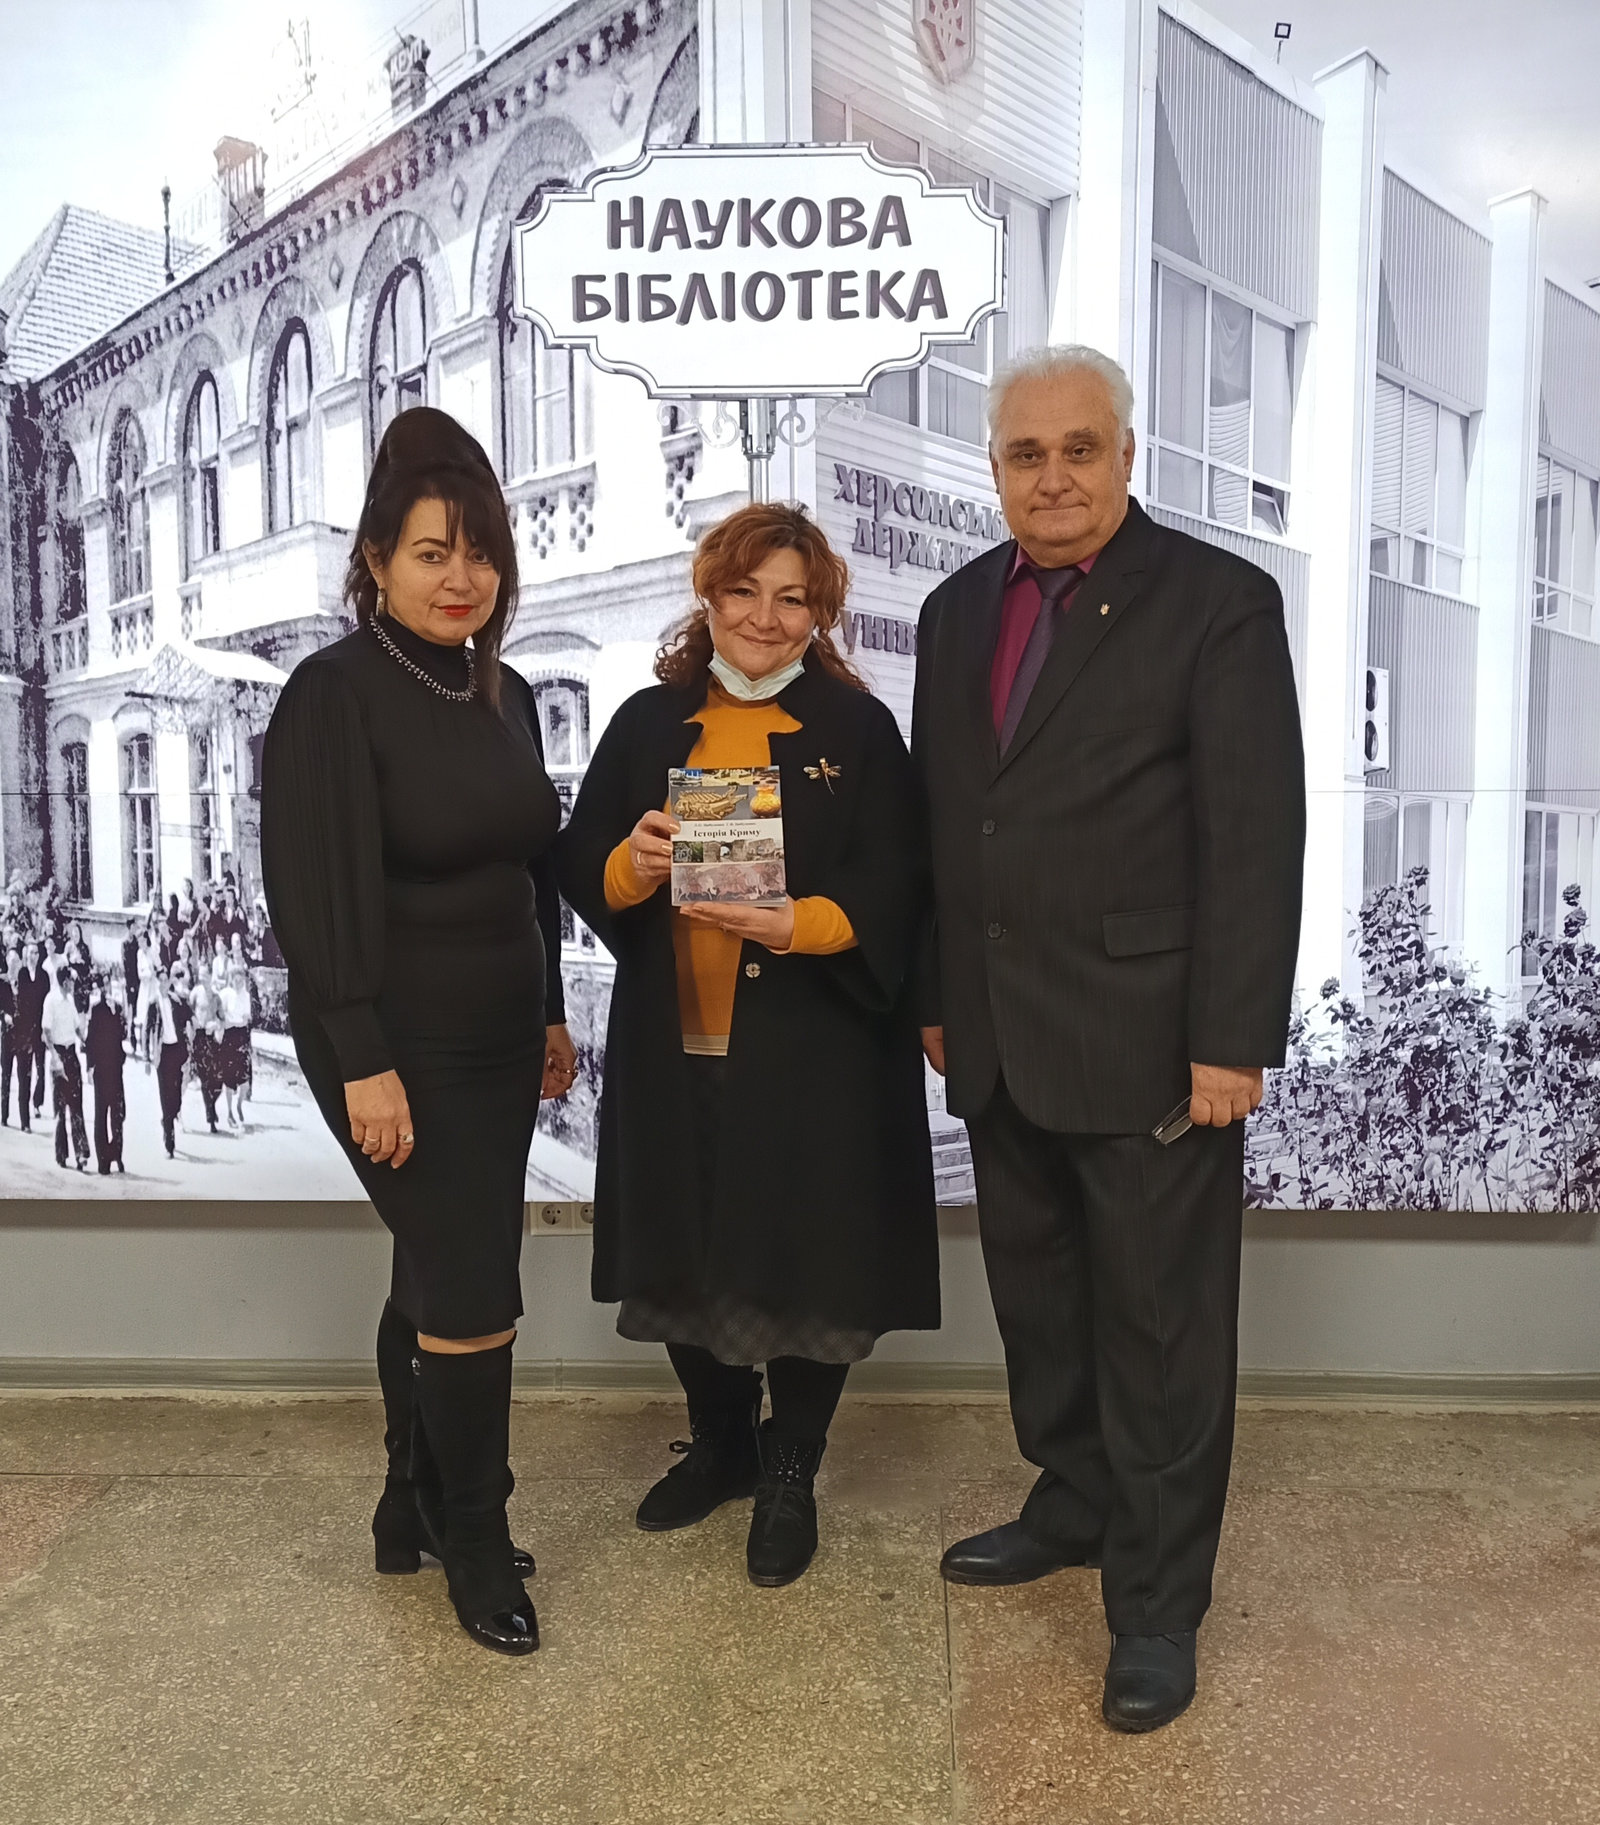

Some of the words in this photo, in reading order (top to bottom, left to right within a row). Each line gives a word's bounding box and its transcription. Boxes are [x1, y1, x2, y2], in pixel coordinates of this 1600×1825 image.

[606, 195, 912, 252] НАУКОВА
[571, 269, 949, 325] БІБЛІОТЕКА
[839, 609, 918, 656] УНІВ
[693, 829, 727, 839] Історія
[729, 828, 760, 837] Криму
